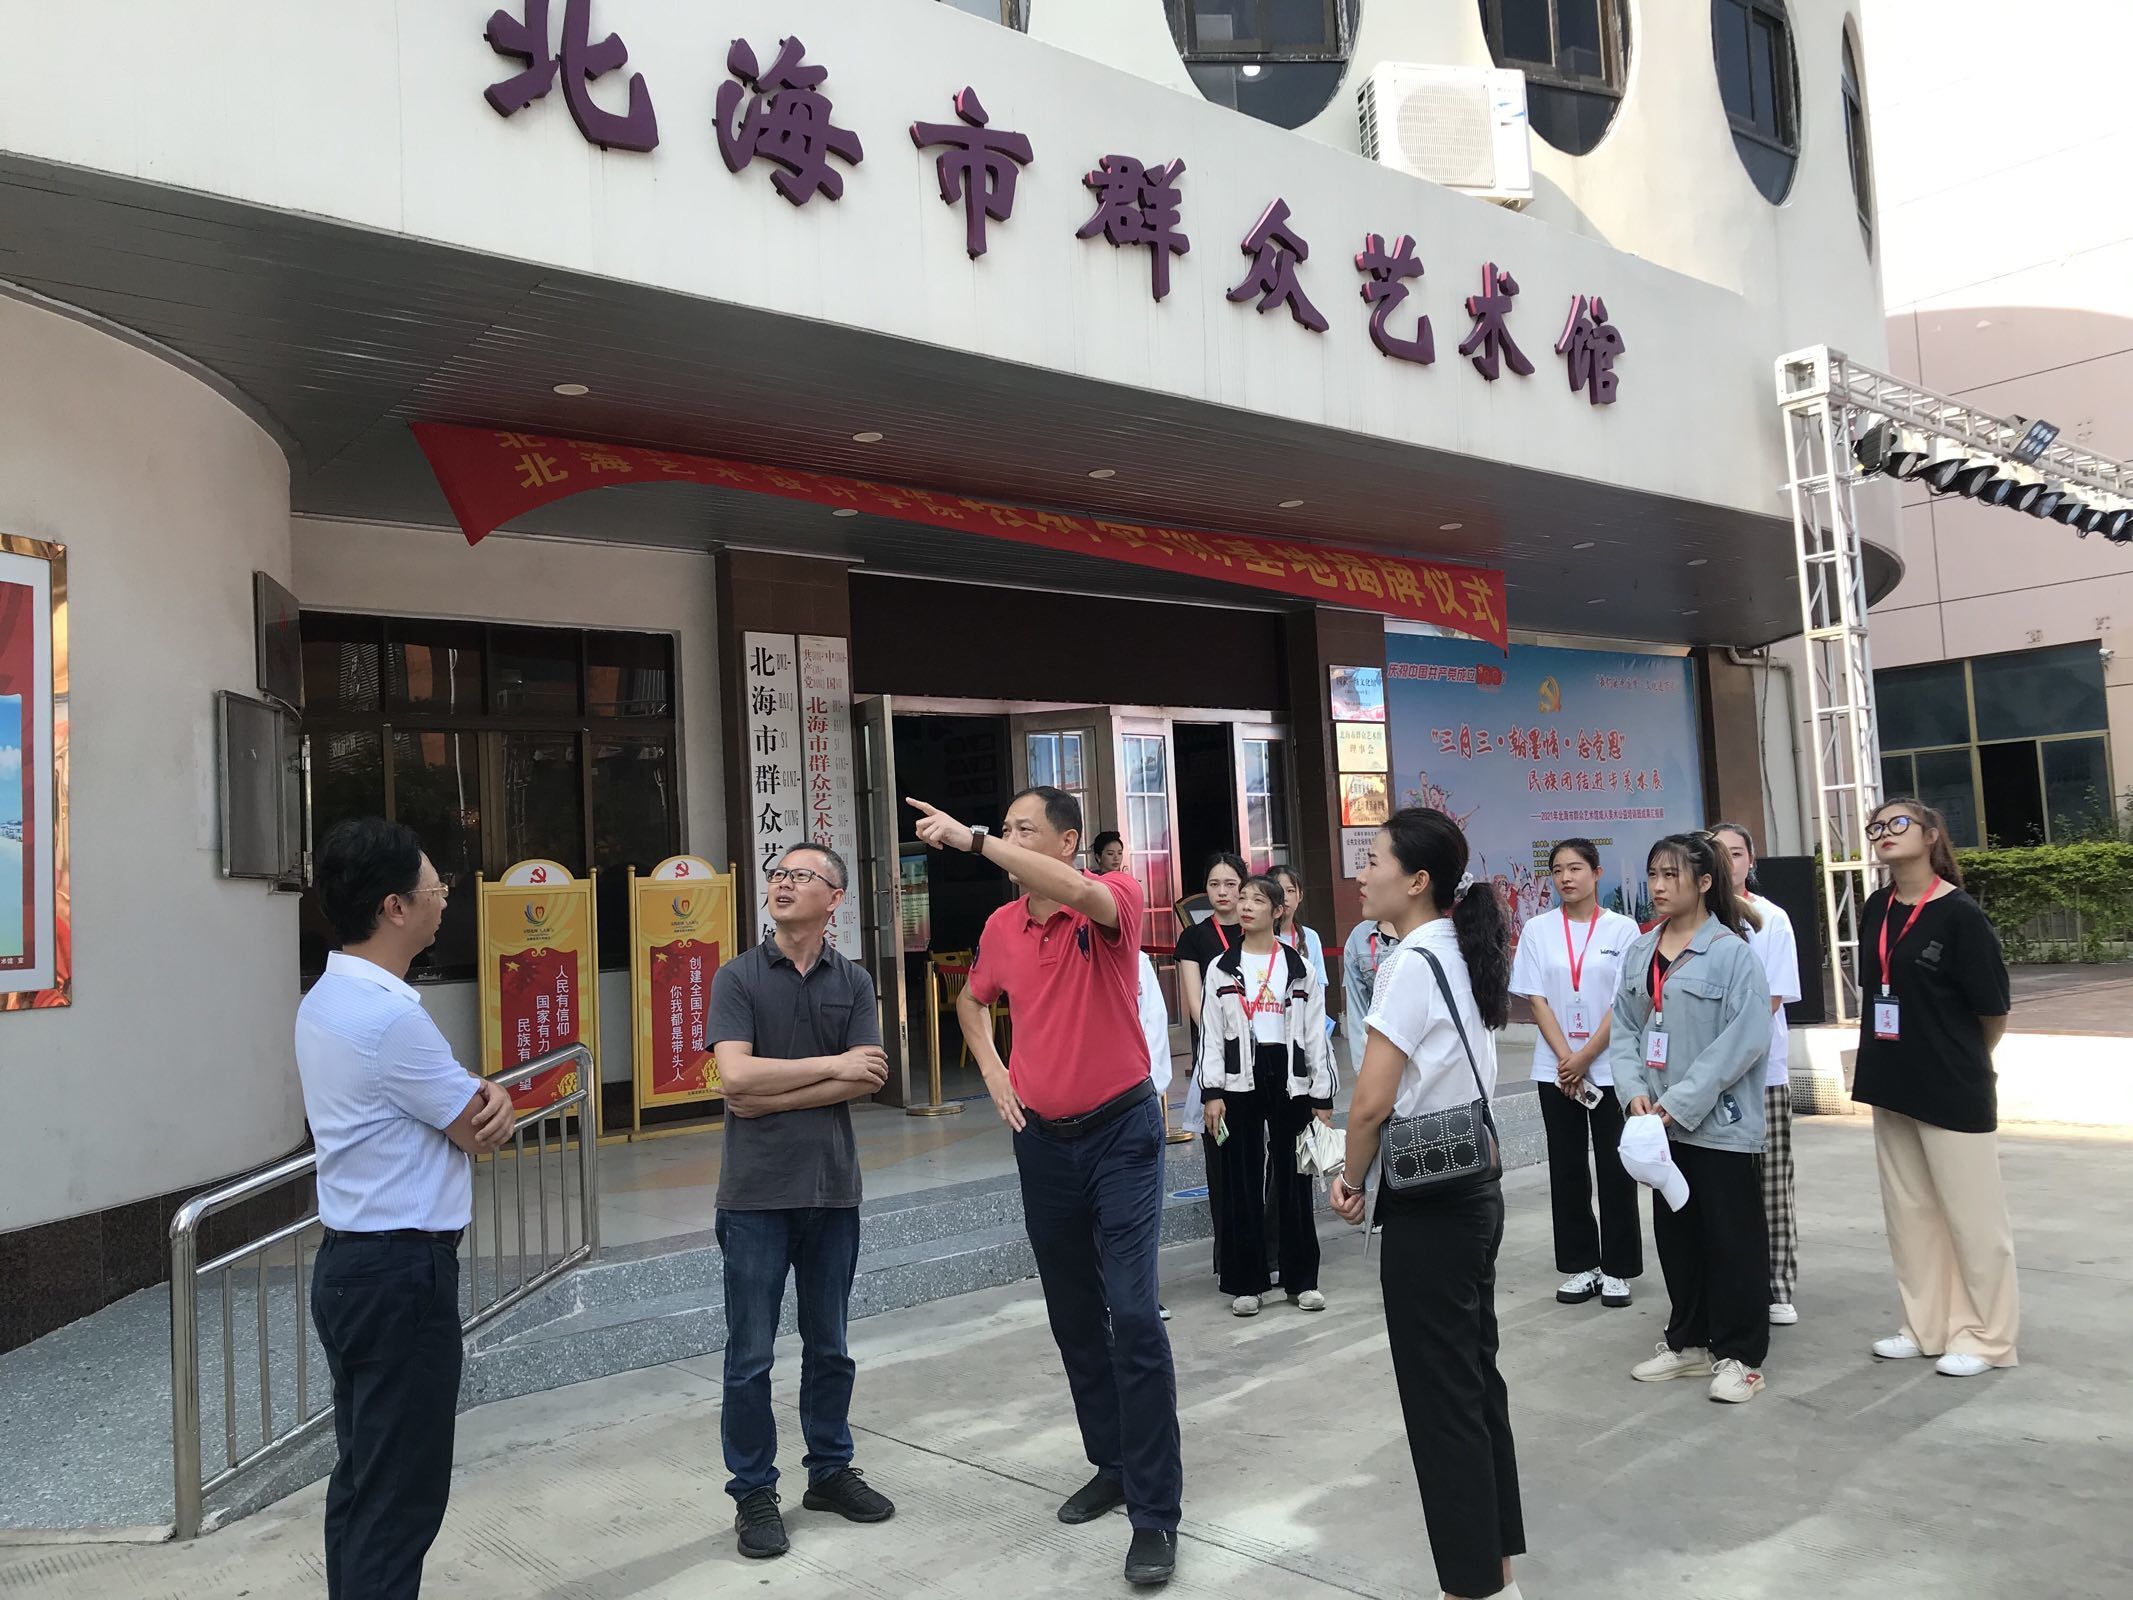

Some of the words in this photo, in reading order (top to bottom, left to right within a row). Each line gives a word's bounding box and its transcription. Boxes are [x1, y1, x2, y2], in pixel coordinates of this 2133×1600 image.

[484, 0, 1626, 405] 北海市群众艺术馆
[1528, 767, 1664, 793] 民族团结进步美术展
[536, 995, 550, 1055] 国家有力
[555, 965, 570, 1036] 人民有信仰
[669, 985, 685, 1082] 你我都是带头人
[689, 956, 704, 1051] 创建全国文明城
[517, 1018, 532, 1091] 民族有望
